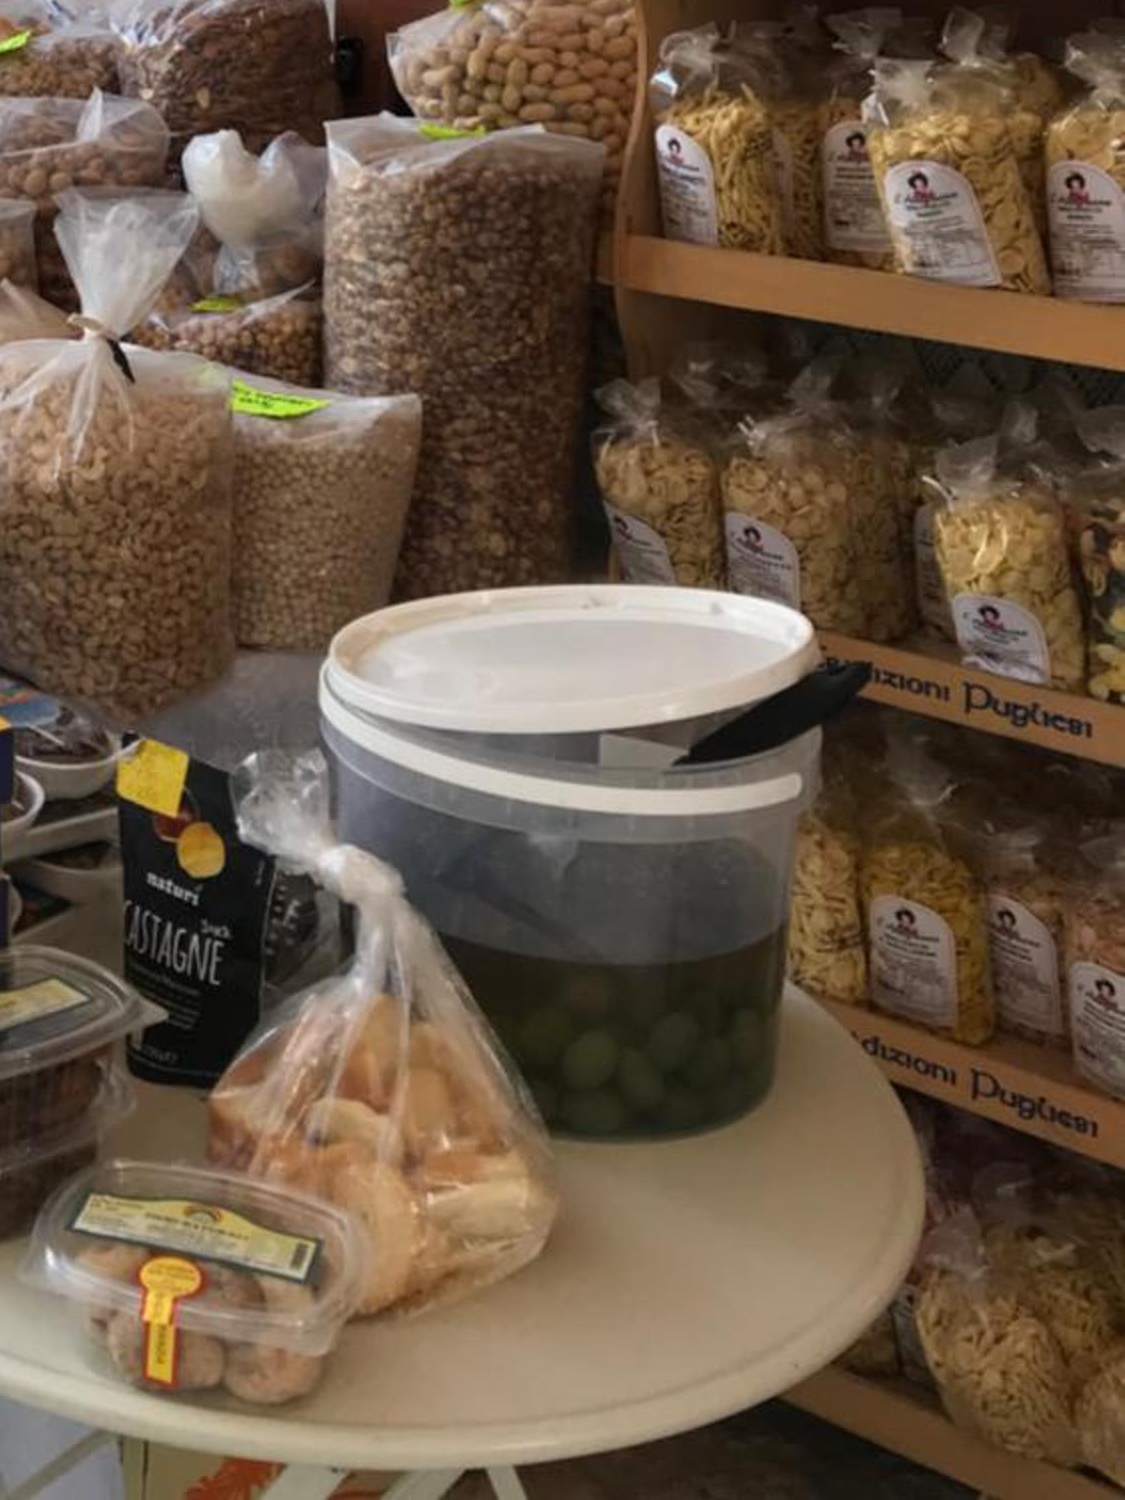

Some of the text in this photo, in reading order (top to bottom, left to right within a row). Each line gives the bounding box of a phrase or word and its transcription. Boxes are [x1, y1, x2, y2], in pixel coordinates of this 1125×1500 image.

[963, 680, 1093, 739] Pugliesi
[861, 1035, 1100, 1138] dizioni Pugliesi
